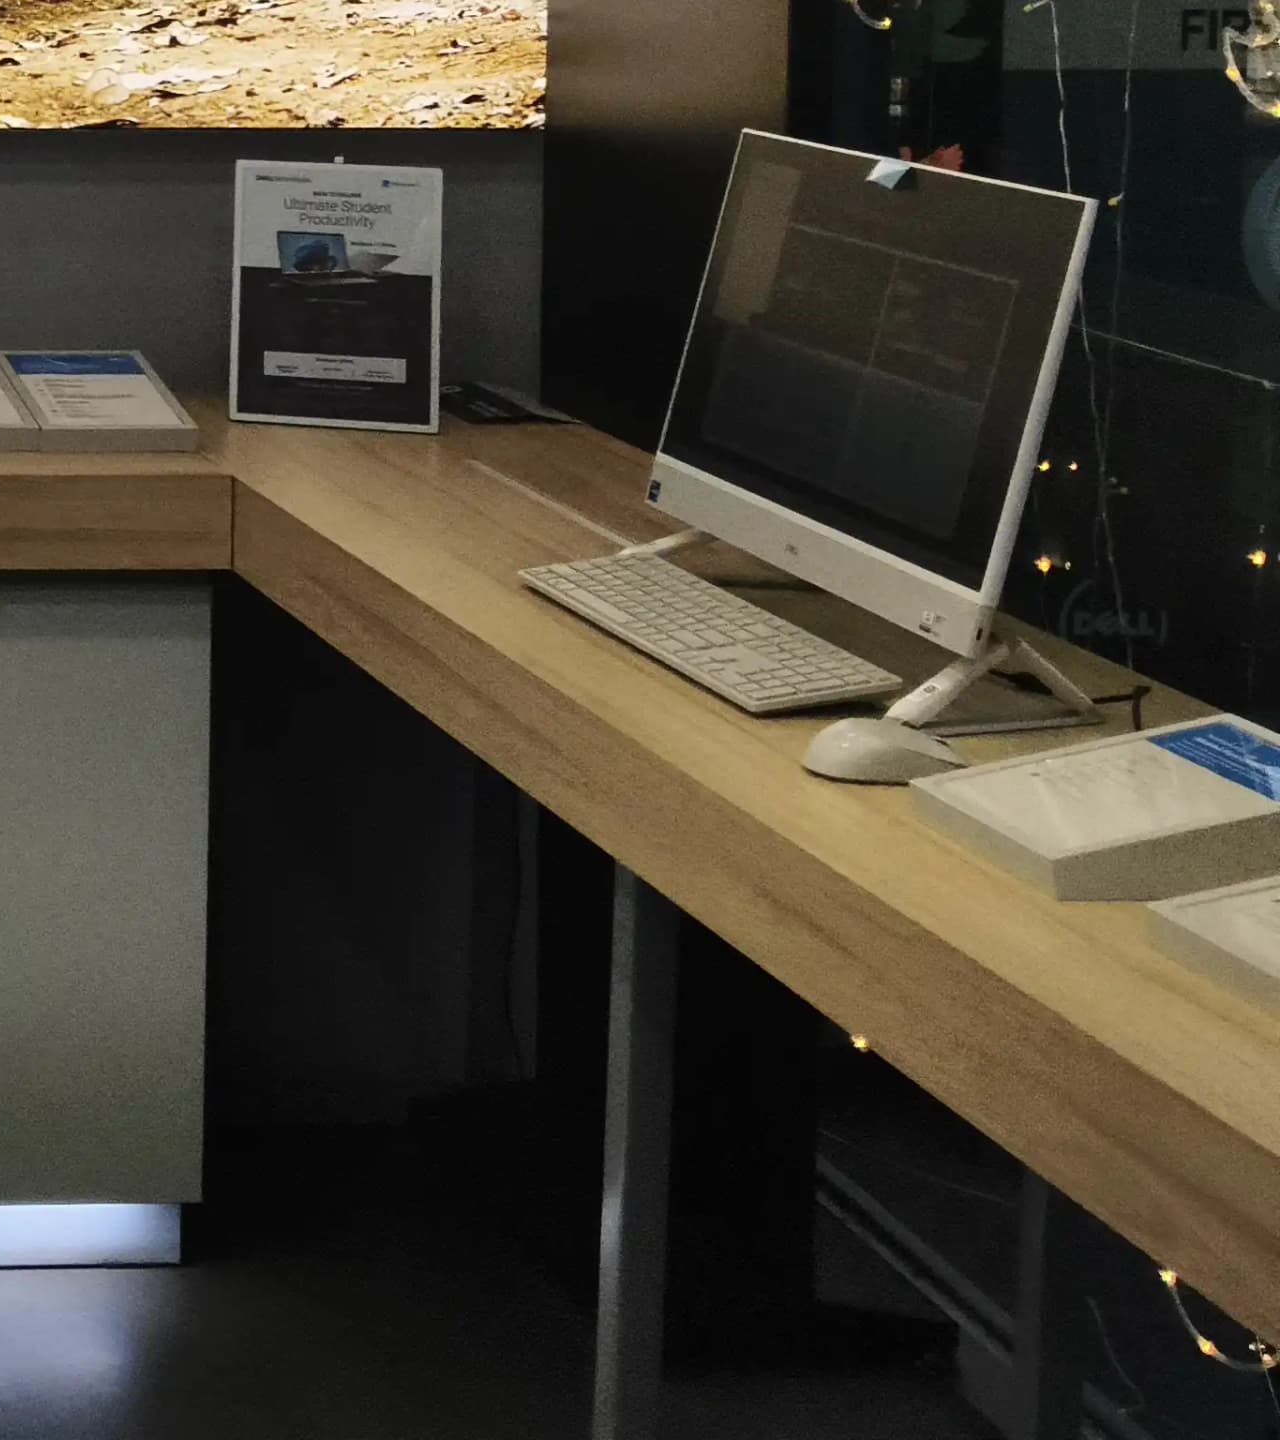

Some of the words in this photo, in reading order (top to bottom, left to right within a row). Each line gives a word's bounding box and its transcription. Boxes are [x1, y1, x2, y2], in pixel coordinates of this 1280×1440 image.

[283, 198, 339, 213] Ultimate
[342, 199, 393, 215] Student
[298, 212, 377, 230] Productivity
